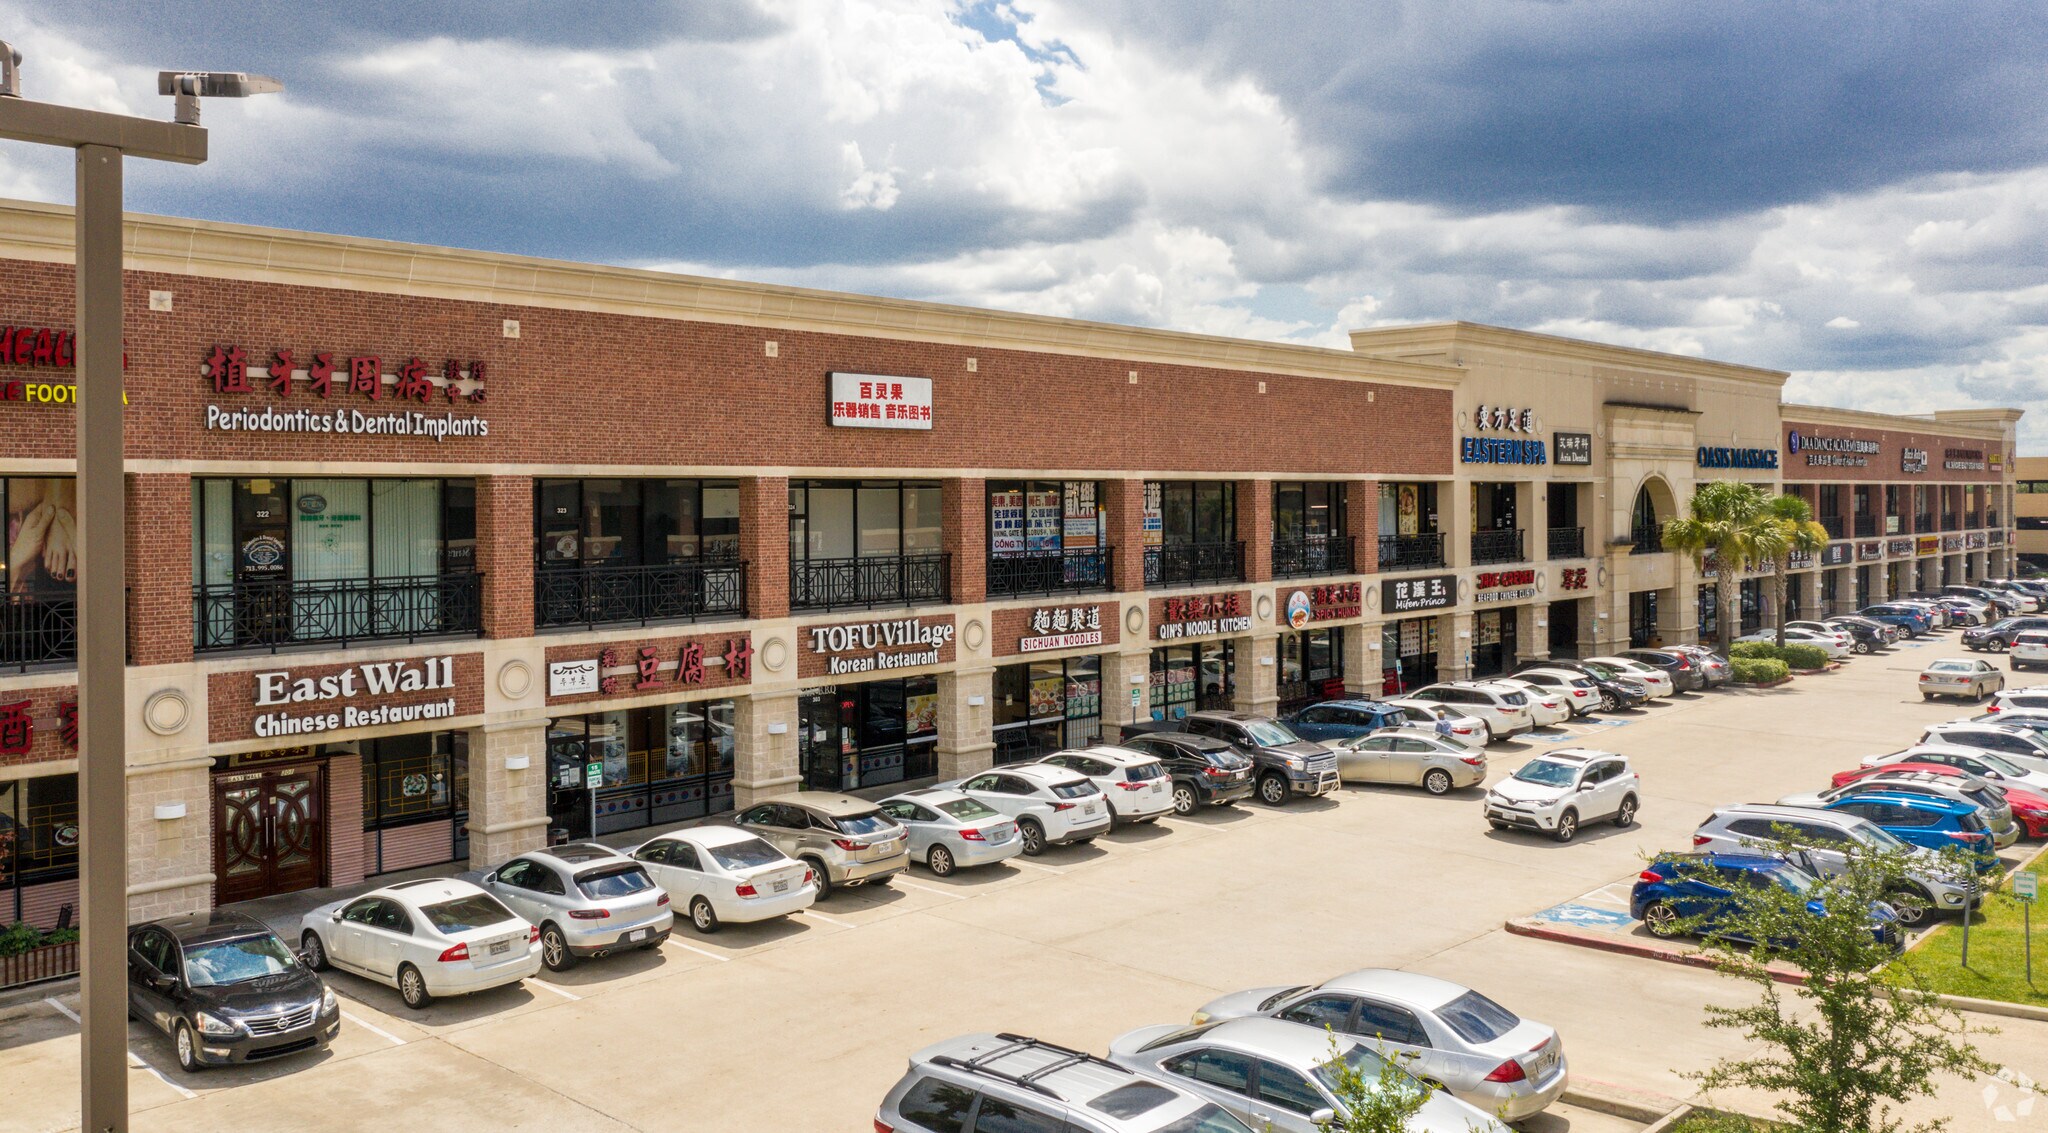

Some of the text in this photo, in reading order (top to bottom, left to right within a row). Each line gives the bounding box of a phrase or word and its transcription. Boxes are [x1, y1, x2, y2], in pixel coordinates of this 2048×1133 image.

[207, 346, 434, 403] 植牙牙周病
[25, 383, 77, 403] FOOT
[860, 382, 903, 400] 百灵果
[833, 402, 930, 420] 乐器销售 音乐图书
[1479, 405, 1534, 434] 東方足道
[208, 405, 488, 442] Periodontics & Dental Implants
[1464, 437, 1547, 465] EASTERN SPA
[1814, 437, 1832, 450] DANCE
[1833, 438, 1856, 451] ACADEMY
[1572, 452, 1588, 463] Dental
[1697, 446, 1778, 469] OASIS MASSAGE
[256, 511, 270, 519] 322
[994, 538, 1014, 548] CÔNG
[1016, 539, 1024, 547] TY
[1396, 579, 1442, 599] 花溪王
[1478, 572, 1500, 589] JADE
[1395, 597, 1447, 610] Mifen Prince
[1478, 592, 1499, 602] SEAFOOD
[1501, 590, 1518, 600] CHINESE
[1316, 606, 1361, 621] SPICY HUNAN
[812, 619, 954, 653] TOFU Village
[1160, 616, 1252, 639] QIN'S NOODLE KITCHEN
[1024, 633, 1099, 650] SICHUAN NOODLES
[635, 639, 755, 690] 豆腐村
[831, 649, 938, 674] Korean Restaurant
[255, 655, 456, 706] East Wall
[255, 698, 456, 737] Chinese Restaurant
